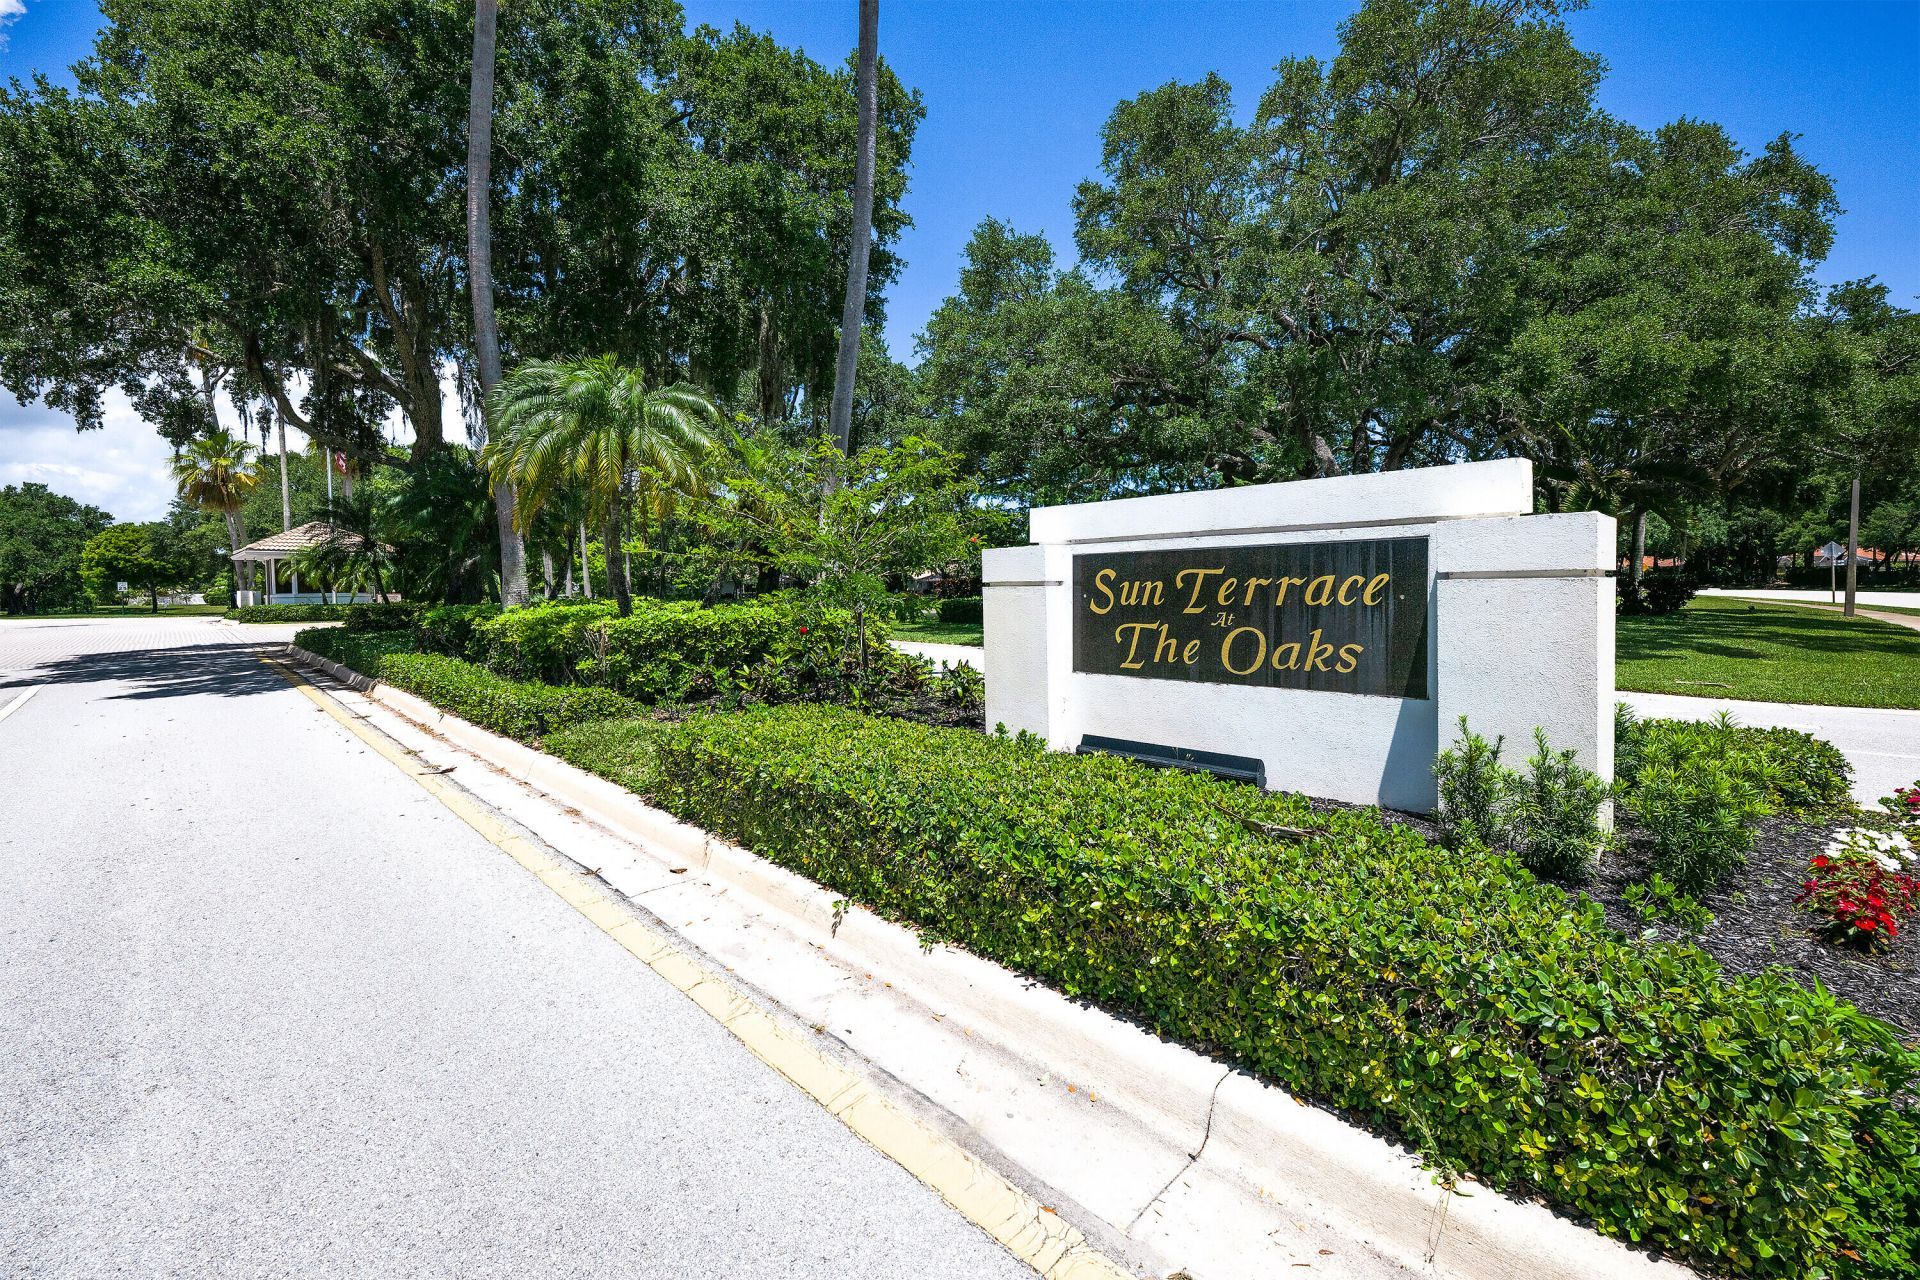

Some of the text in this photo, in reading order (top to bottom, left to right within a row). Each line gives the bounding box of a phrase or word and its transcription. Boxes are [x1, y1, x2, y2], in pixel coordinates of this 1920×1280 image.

[1089, 565, 1390, 615] Sun Terrace
[1211, 611, 1236, 627] At
[1115, 619, 1364, 675] The Oaks
